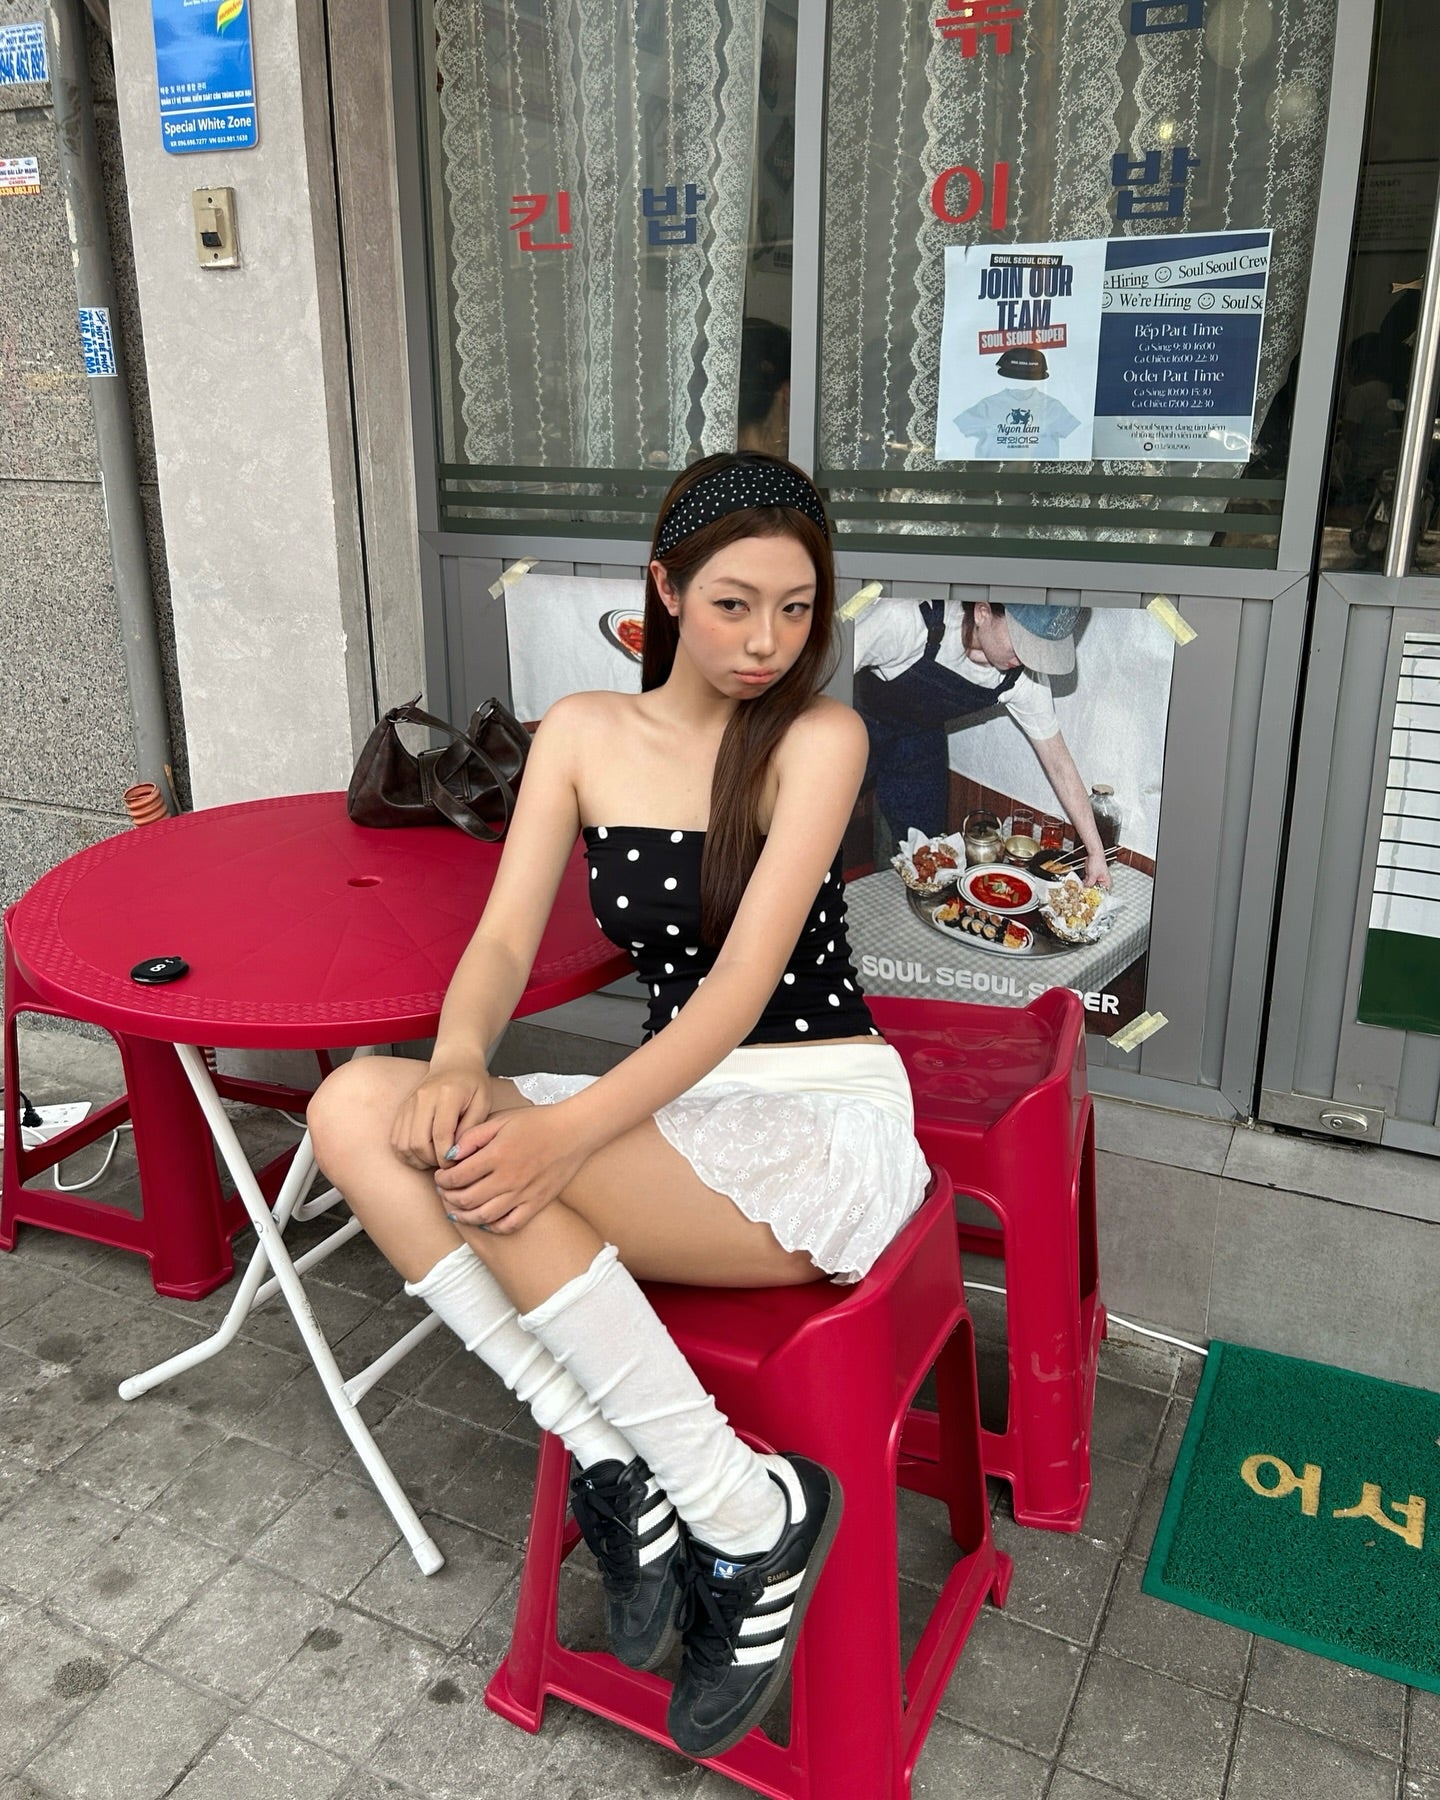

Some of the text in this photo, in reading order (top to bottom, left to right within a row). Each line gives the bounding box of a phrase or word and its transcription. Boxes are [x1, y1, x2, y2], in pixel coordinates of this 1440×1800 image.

[164, 115, 252, 137] Special White Zone
[1112, 147, 1200, 221] 밥
[508, 191, 574, 252] 킨
[642, 182, 706, 246] 밥
[993, 255, 1060, 265] SOUL SEOUL CREW
[1111, 272, 1149, 289] Hiring
[1178, 262, 1204, 279] Soul
[1205, 257, 1237, 275] Seoul
[1239, 255, 1268, 270] Crew
[978, 265, 1074, 300] JOIN OUR
[997, 299, 1052, 331] TEAM
[1154, 293, 1192, 311] Hiring
[1221, 295, 1249, 310] Soul
[981, 327, 1065, 349] SOUL SEOUL SUPER
[1134, 322, 1224, 340] Bếp Part Time
[1123, 368, 1225, 383] Order Part Time
[861, 954, 931, 984] SOUL
[935, 966, 1024, 999] SEOUL
